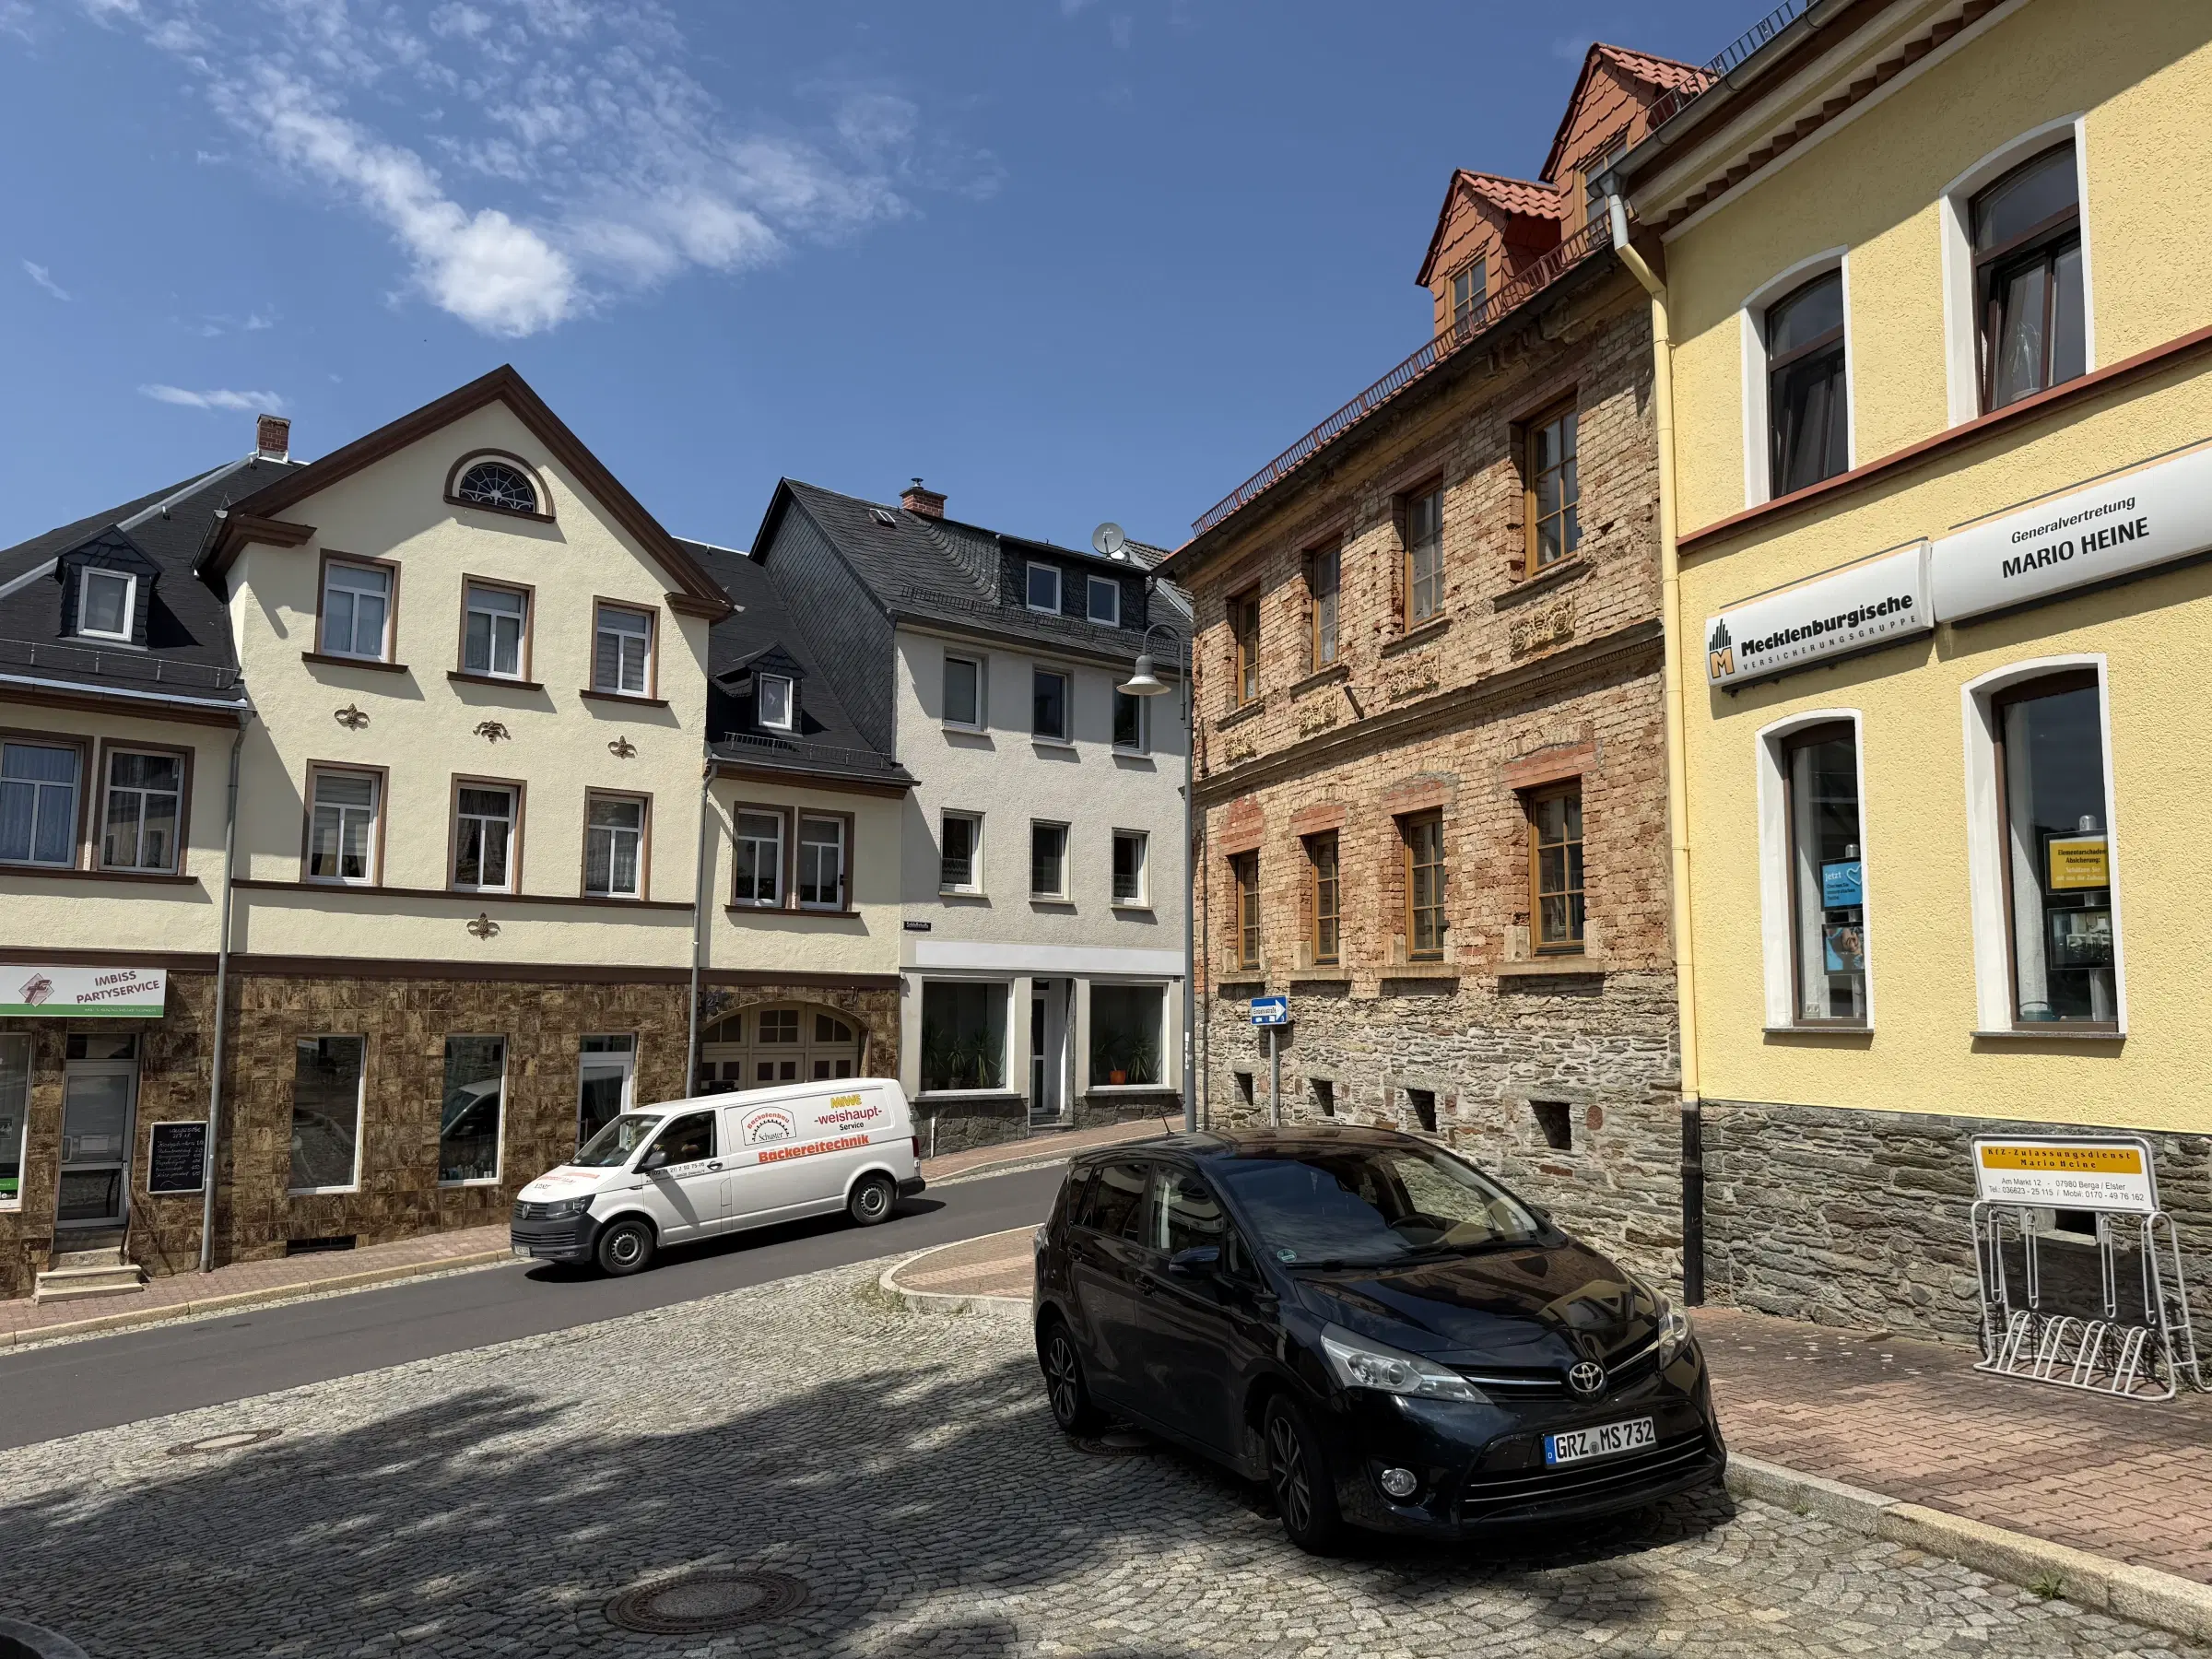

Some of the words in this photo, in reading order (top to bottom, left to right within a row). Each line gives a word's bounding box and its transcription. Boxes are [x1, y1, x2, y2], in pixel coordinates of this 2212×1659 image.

[2011, 496, 2136, 544] Generalvertretung
[2002, 540, 2074, 579] MARIO
[2080, 516, 2149, 555] HEINE
[1741, 594, 1913, 657] Mecklenburgische
[1743, 615, 1916, 670] VERSICHERUNGSGRUPPE
[1825, 871, 1841, 882] Jetzt
[94, 971, 137, 986] IMBISS
[76, 980, 160, 1004] PARTYSERVICE
[747, 1112, 790, 1130] Backofenbau
[814, 1105, 882, 1125] -weishaupt-
[839, 1121, 865, 1131] Service
[759, 1132, 783, 1141] Schuster
[2060, 1160, 2097, 1169] Heine
[1988, 1185, 2001, 1194] Tel.:
[2002, 1186, 2026, 1194] 036623
[2041, 1188, 2053, 1196] 115
[2063, 1189, 2084, 1197] Mobil:
[2085, 1190, 2103, 1198] 0170
[2109, 1192, 2119, 1200] 49
[2121, 1193, 2130, 1201] 76
[2131, 1194, 2145, 1202] 162
[2013, 1178, 2032, 1186] Markt
[2055, 1180, 2077, 1188] 07980
[2078, 1181, 2100, 1190] Berga
[2105, 1182, 2125, 1191] Elster
[1555, 1432, 1589, 1459] GRZ
[1599, 1426, 1622, 1451] MS
[1623, 1419, 1654, 1446] 732
